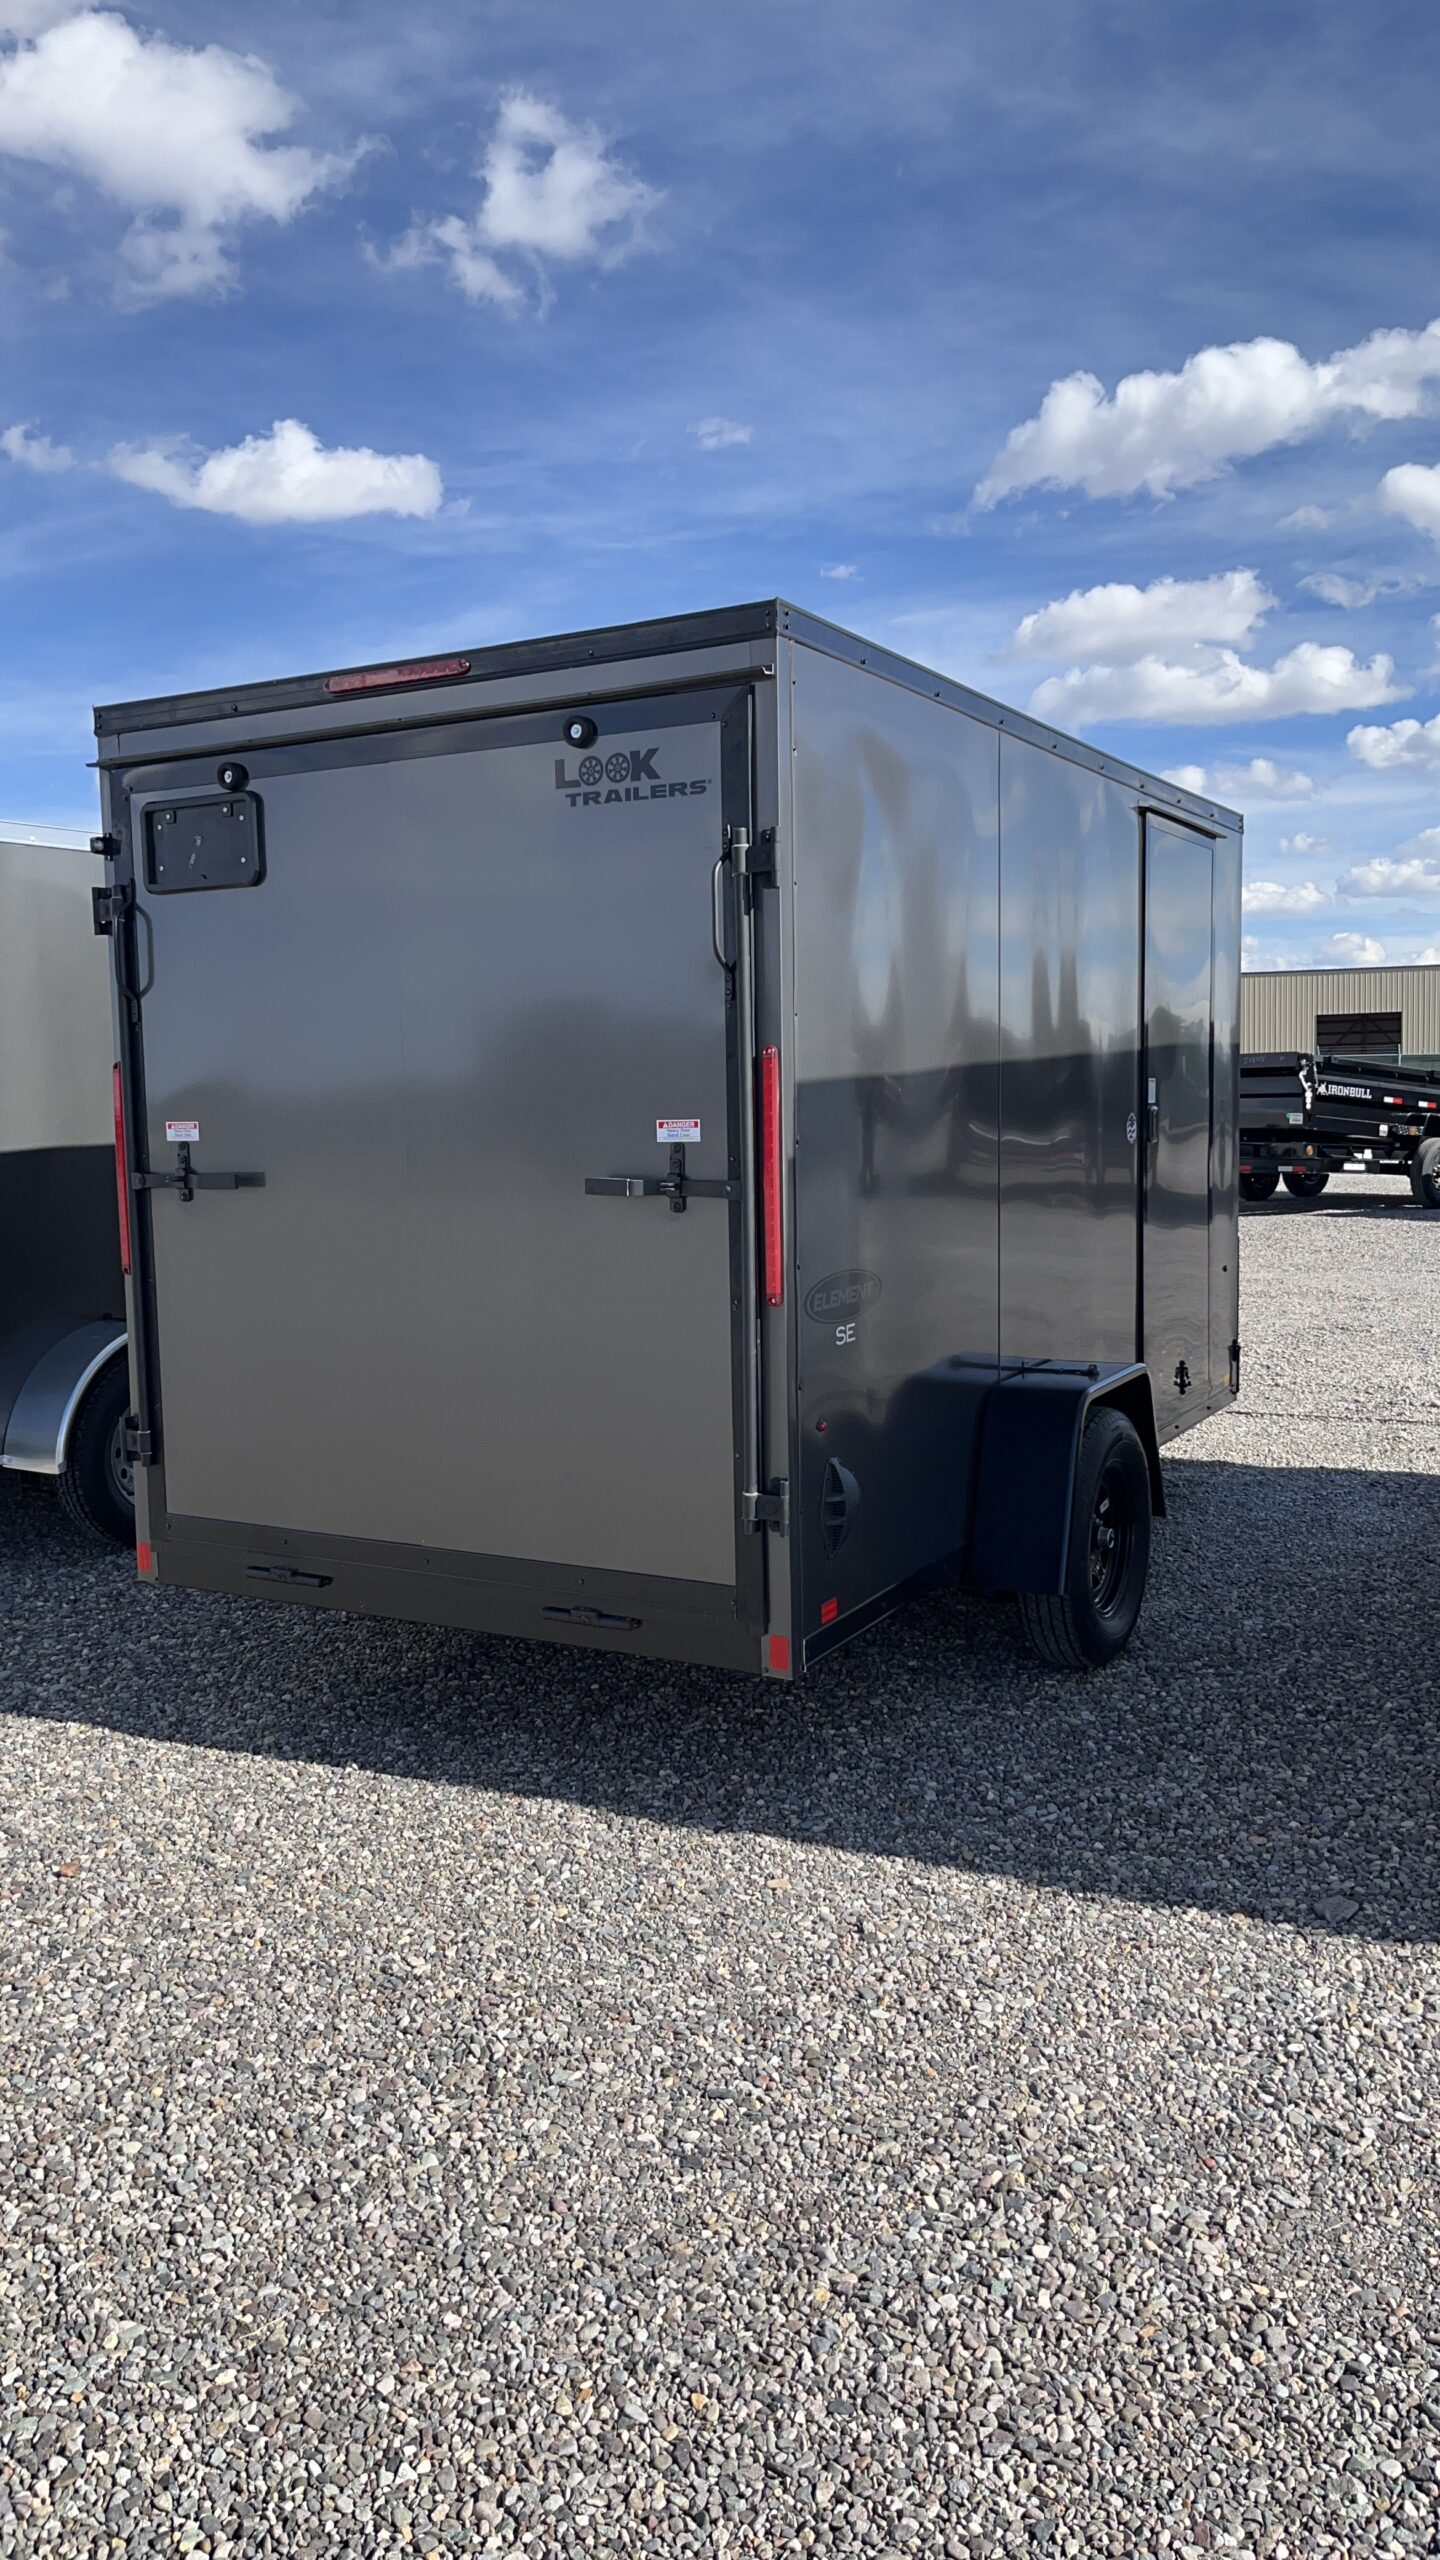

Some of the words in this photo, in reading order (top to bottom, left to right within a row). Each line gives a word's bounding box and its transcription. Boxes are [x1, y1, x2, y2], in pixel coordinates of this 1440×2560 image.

[555, 748, 661, 789] LOOK
[565, 780, 708, 807] TRAILERS
[1328, 1084, 1372, 1099] IRONBULL
[668, 1121, 695, 1129] DANGER
[813, 1281, 875, 1313] ELEMENT
[835, 1322, 856, 1346] SE
